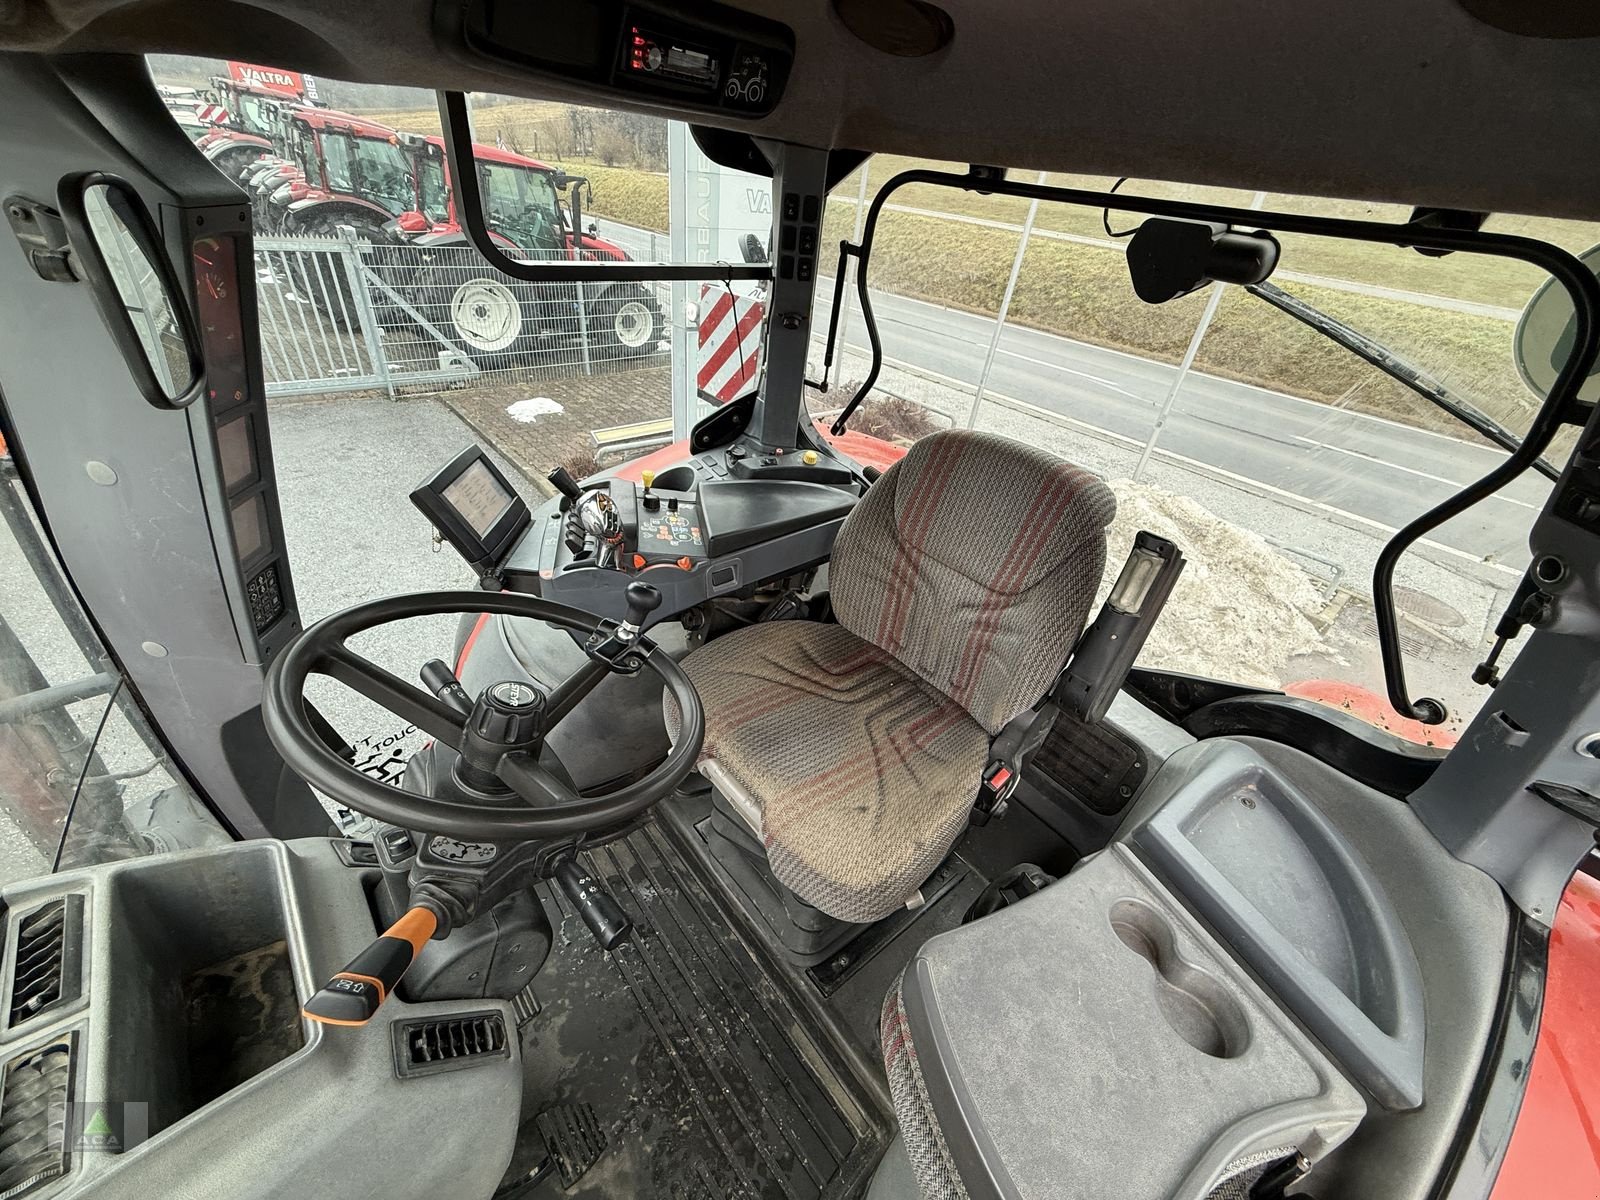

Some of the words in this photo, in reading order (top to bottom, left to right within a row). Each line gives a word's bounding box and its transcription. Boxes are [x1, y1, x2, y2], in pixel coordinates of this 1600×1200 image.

[238, 66, 295, 87] VALTRA
[509, 683, 520, 707] STEYR
[371, 724, 418, 752] TOUC
